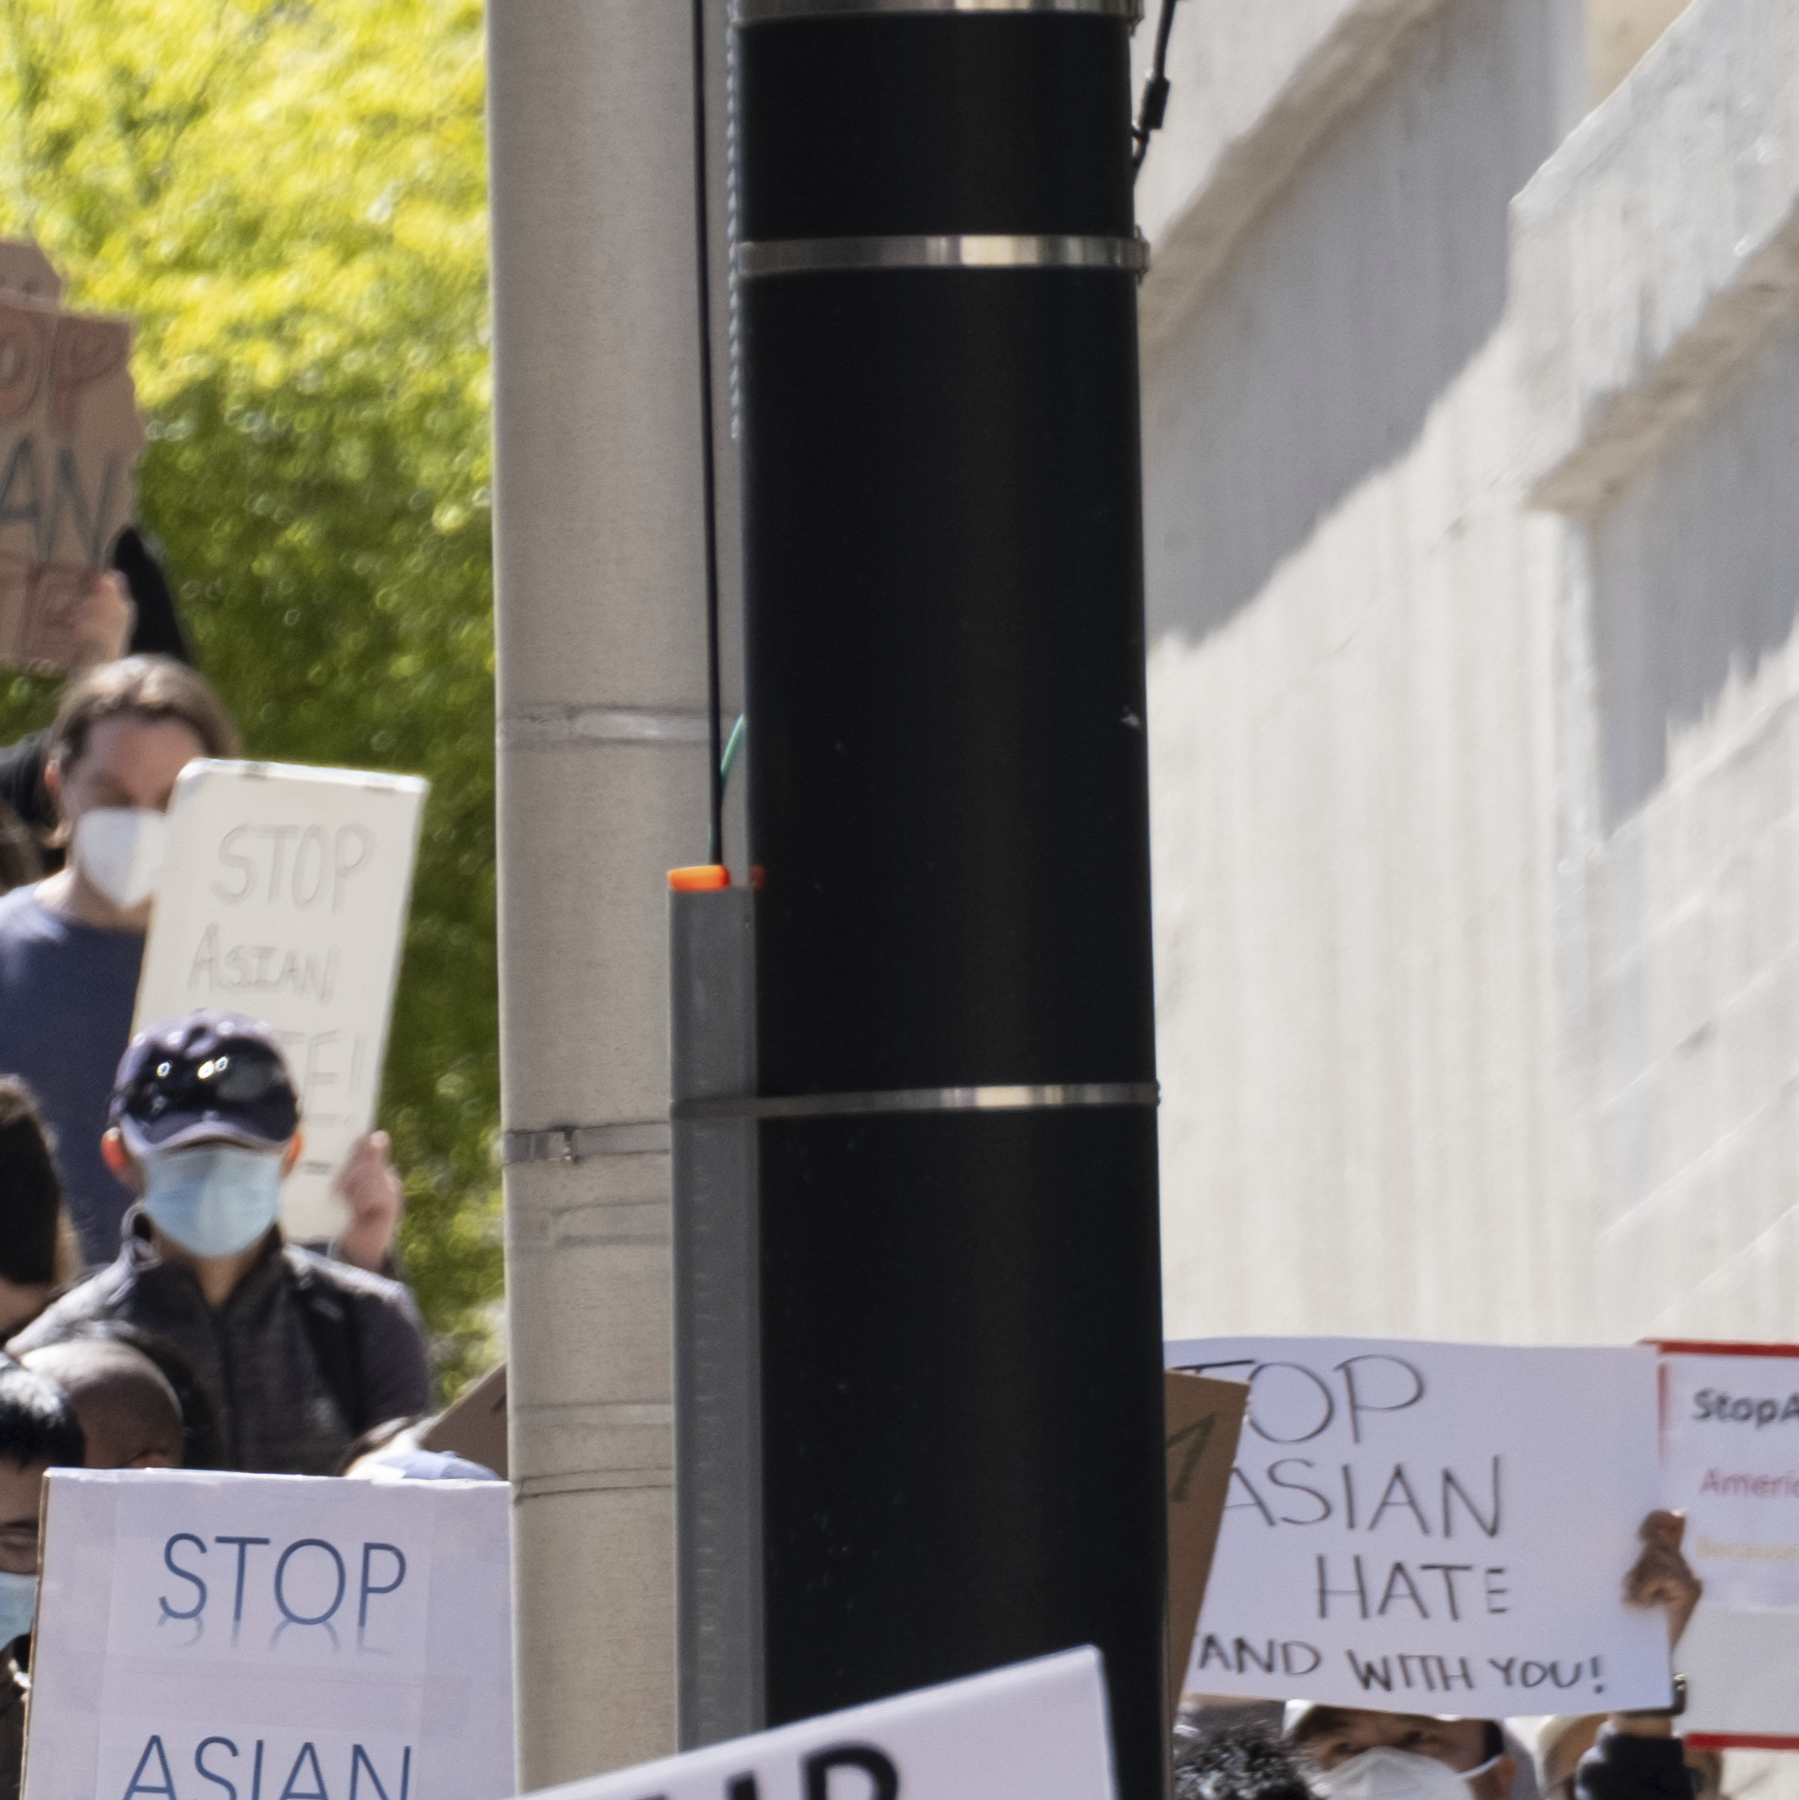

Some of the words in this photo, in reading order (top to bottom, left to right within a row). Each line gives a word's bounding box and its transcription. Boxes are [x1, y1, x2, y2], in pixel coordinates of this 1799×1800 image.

[211, 822, 378, 912] STOP
[188, 921, 341, 1002] ASIAN
[1172, 1354, 1425, 1446] OP
[1225, 1454, 1503, 1539] ASIAN
[158, 1533, 407, 1628] STOP
[1315, 1552, 1510, 1623] HATE
[1346, 1649, 1476, 1693] WITH
[1488, 1653, 1607, 1694] YOU!
